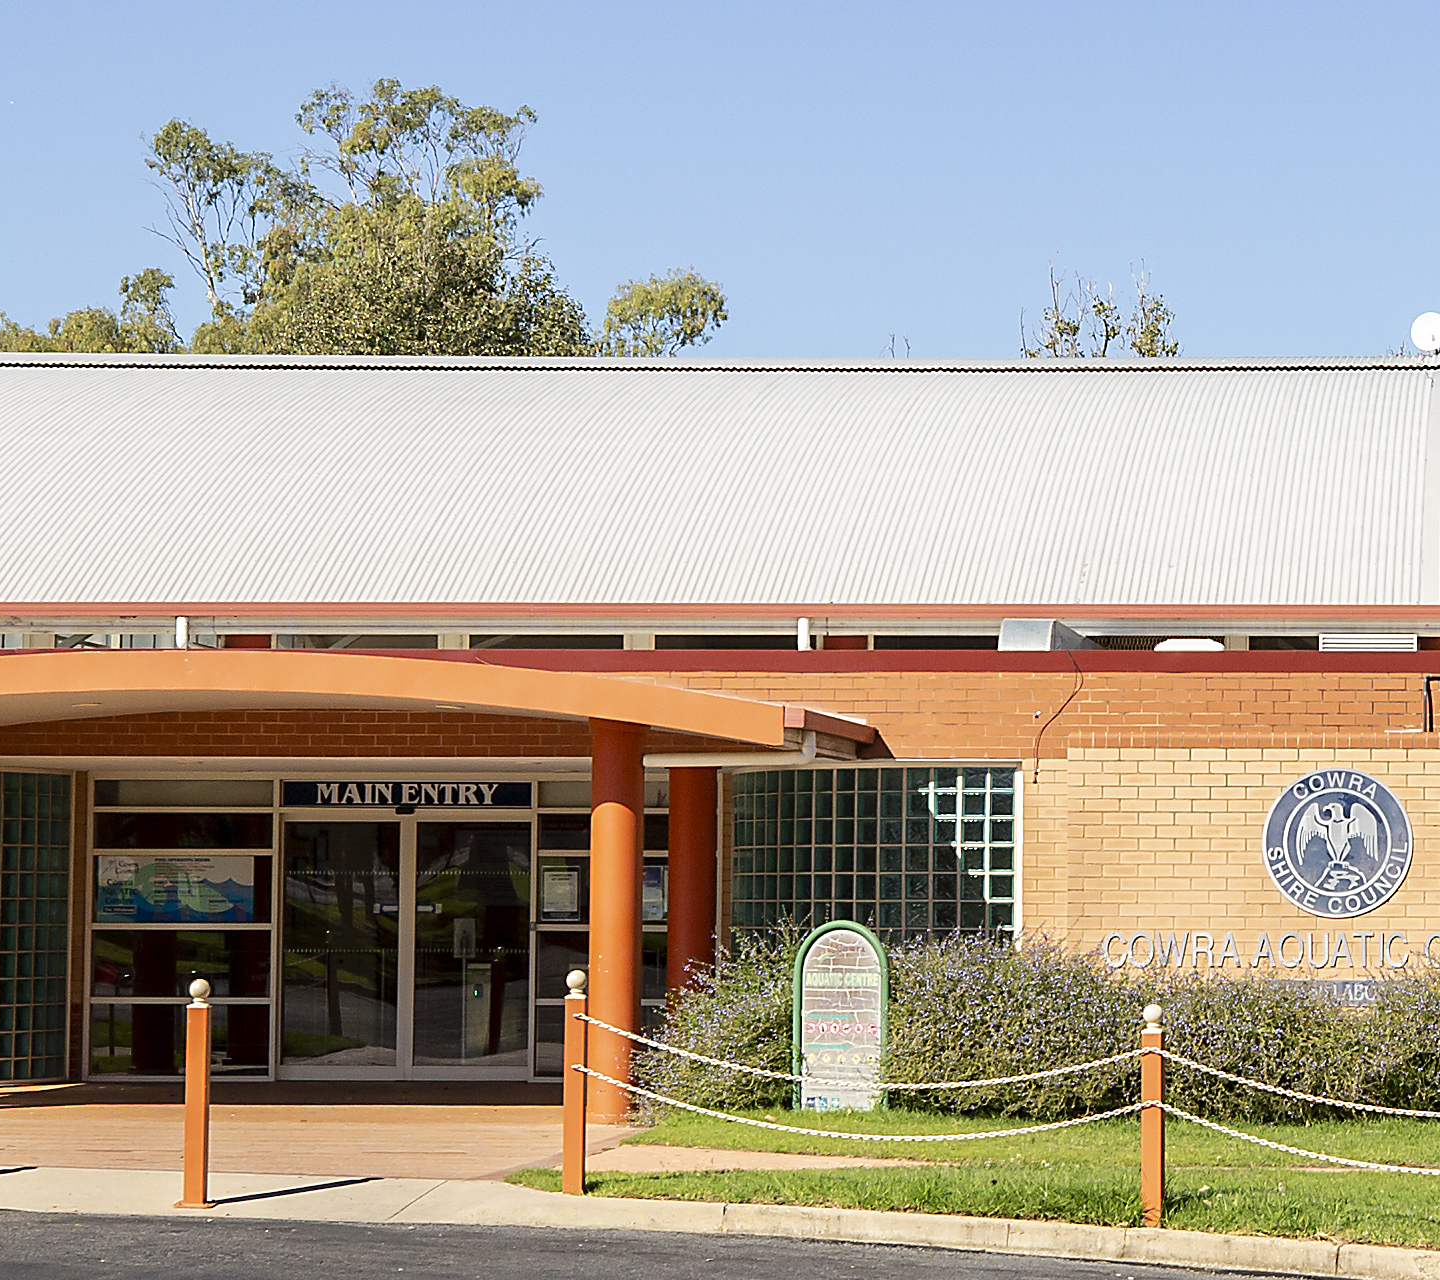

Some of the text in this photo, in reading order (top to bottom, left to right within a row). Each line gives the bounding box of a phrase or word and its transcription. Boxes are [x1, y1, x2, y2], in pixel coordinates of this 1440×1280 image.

[316, 783, 499, 804] MAIN ENTRY
[1292, 772, 1378, 800] COWRA
[1267, 841, 1408, 914] SHIRE COUNCIL
[1103, 932, 1241, 969] COWRA
[1252, 932, 1410, 970] AQUATIC
[844, 972, 879, 987] CENTRE
